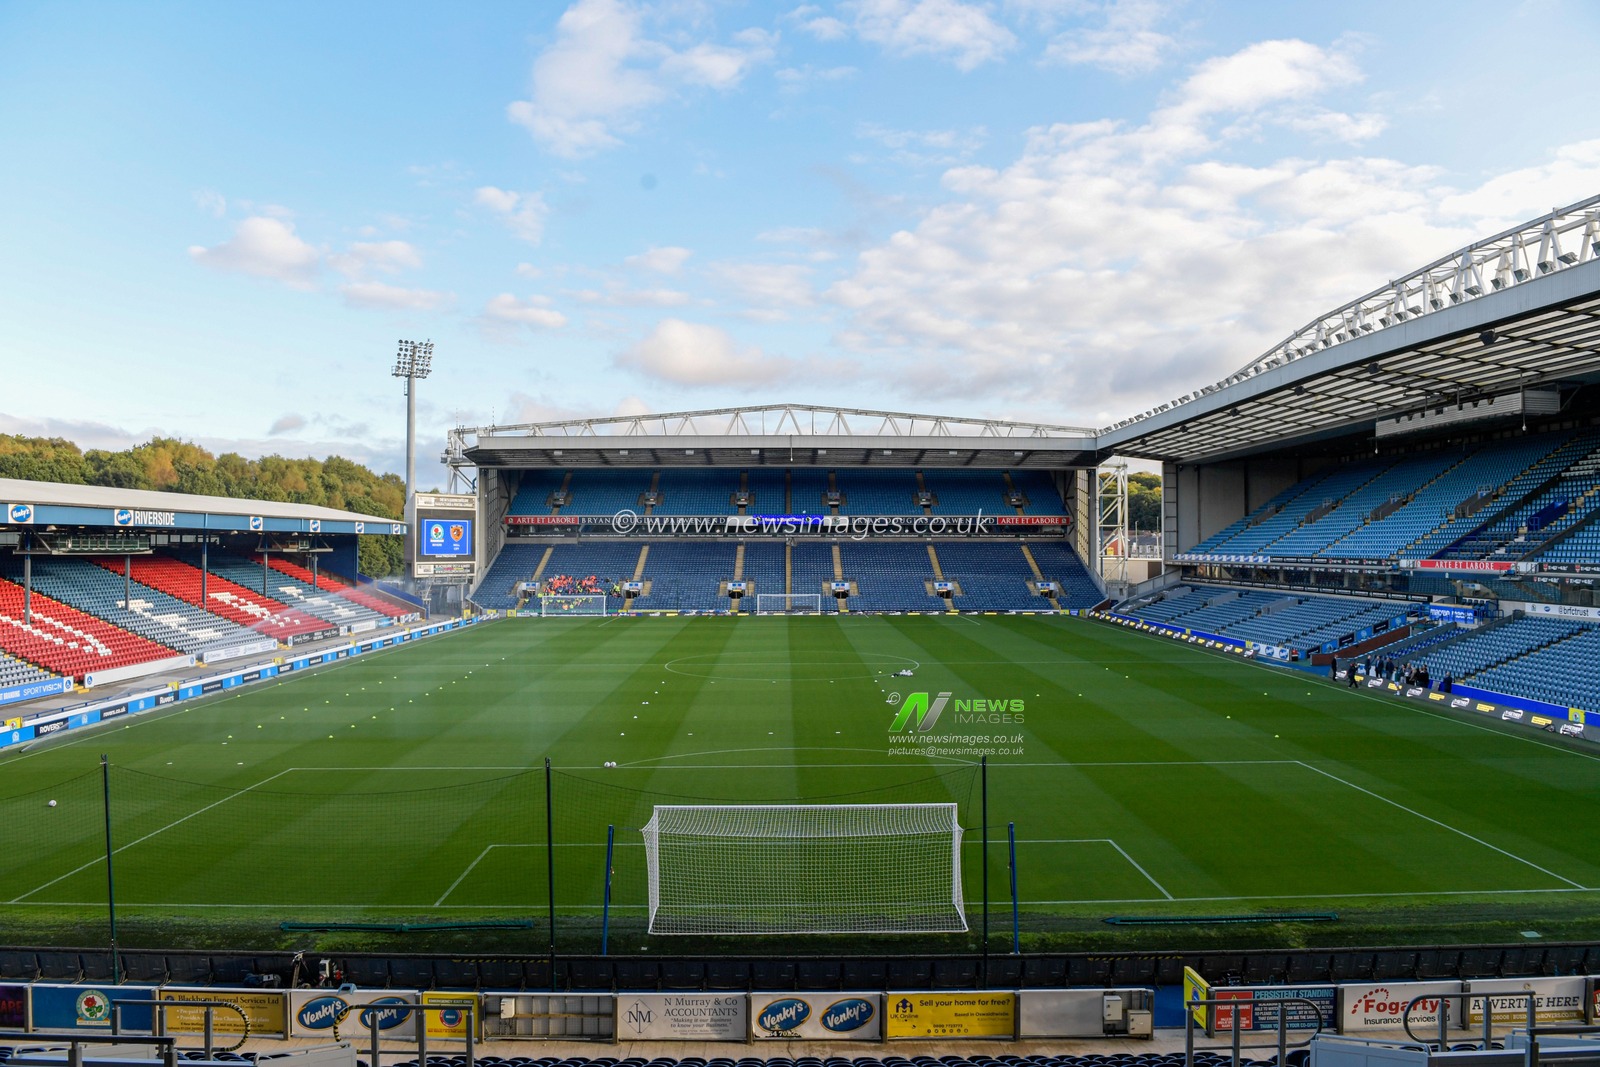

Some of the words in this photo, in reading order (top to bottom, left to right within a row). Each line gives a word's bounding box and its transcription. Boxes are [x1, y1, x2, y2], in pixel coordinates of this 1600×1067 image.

[134, 511, 175, 526] RIVERSIDE
[1435, 561, 1452, 569] ARTE
[1454, 561, 1463, 569] ET
[1465, 561, 1494, 571] LABORE
[1558, 606, 1590, 616] @brfctrust
[23, 682, 62, 696] SPORTVISION
[1254, 990, 1298, 999] PERSISTENT
[1298, 989, 1334, 998] STANDING
[213, 995, 239, 1003] Funeral
[240, 996, 267, 1004] Services
[267, 996, 279, 1004] Ltd
[664, 998, 672, 1006] N
[675, 998, 711, 1007] Murray
[714, 998, 721, 1006] &
[724, 998, 738, 1006] Co
[919, 999, 934, 1007] Sell
[1472, 997, 1544, 1010] AVERTIE
[1546, 996, 1580, 1008] HERE
[303, 1001, 342, 1026] Venky's
[664, 1008, 738, 1017] ACCOUNTANTS
[763, 1002, 804, 1028] Venky's
[826, 1002, 867, 1028] Venky's
[1363, 1016, 1402, 1025] Insurance
[1406, 1015, 1436, 1023] ervices
